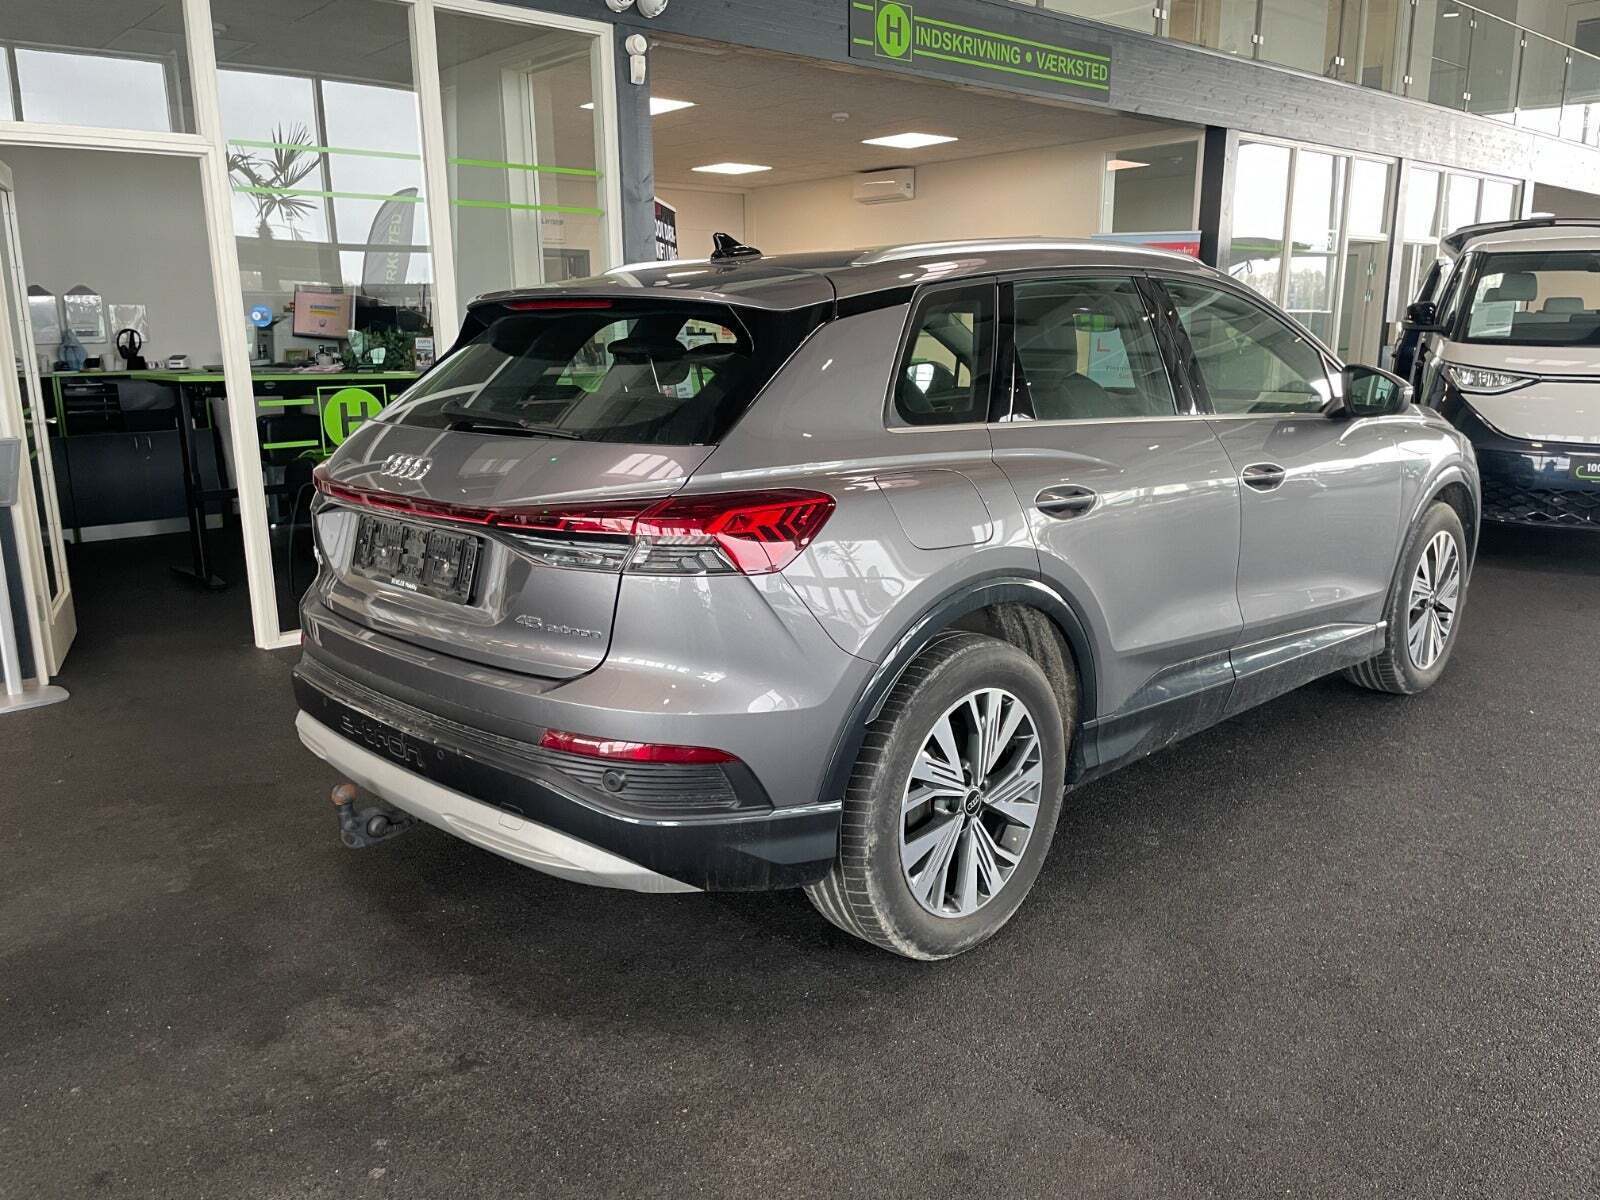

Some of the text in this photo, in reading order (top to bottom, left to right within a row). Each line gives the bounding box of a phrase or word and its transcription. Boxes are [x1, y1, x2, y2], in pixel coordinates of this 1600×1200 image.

[886, 14, 902, 47] H
[916, 25, 1108, 81] INDSKRIVNING VÆRKSTED
[545, 623, 602, 639] e-tron
[341, 714, 425, 769] e-tron
